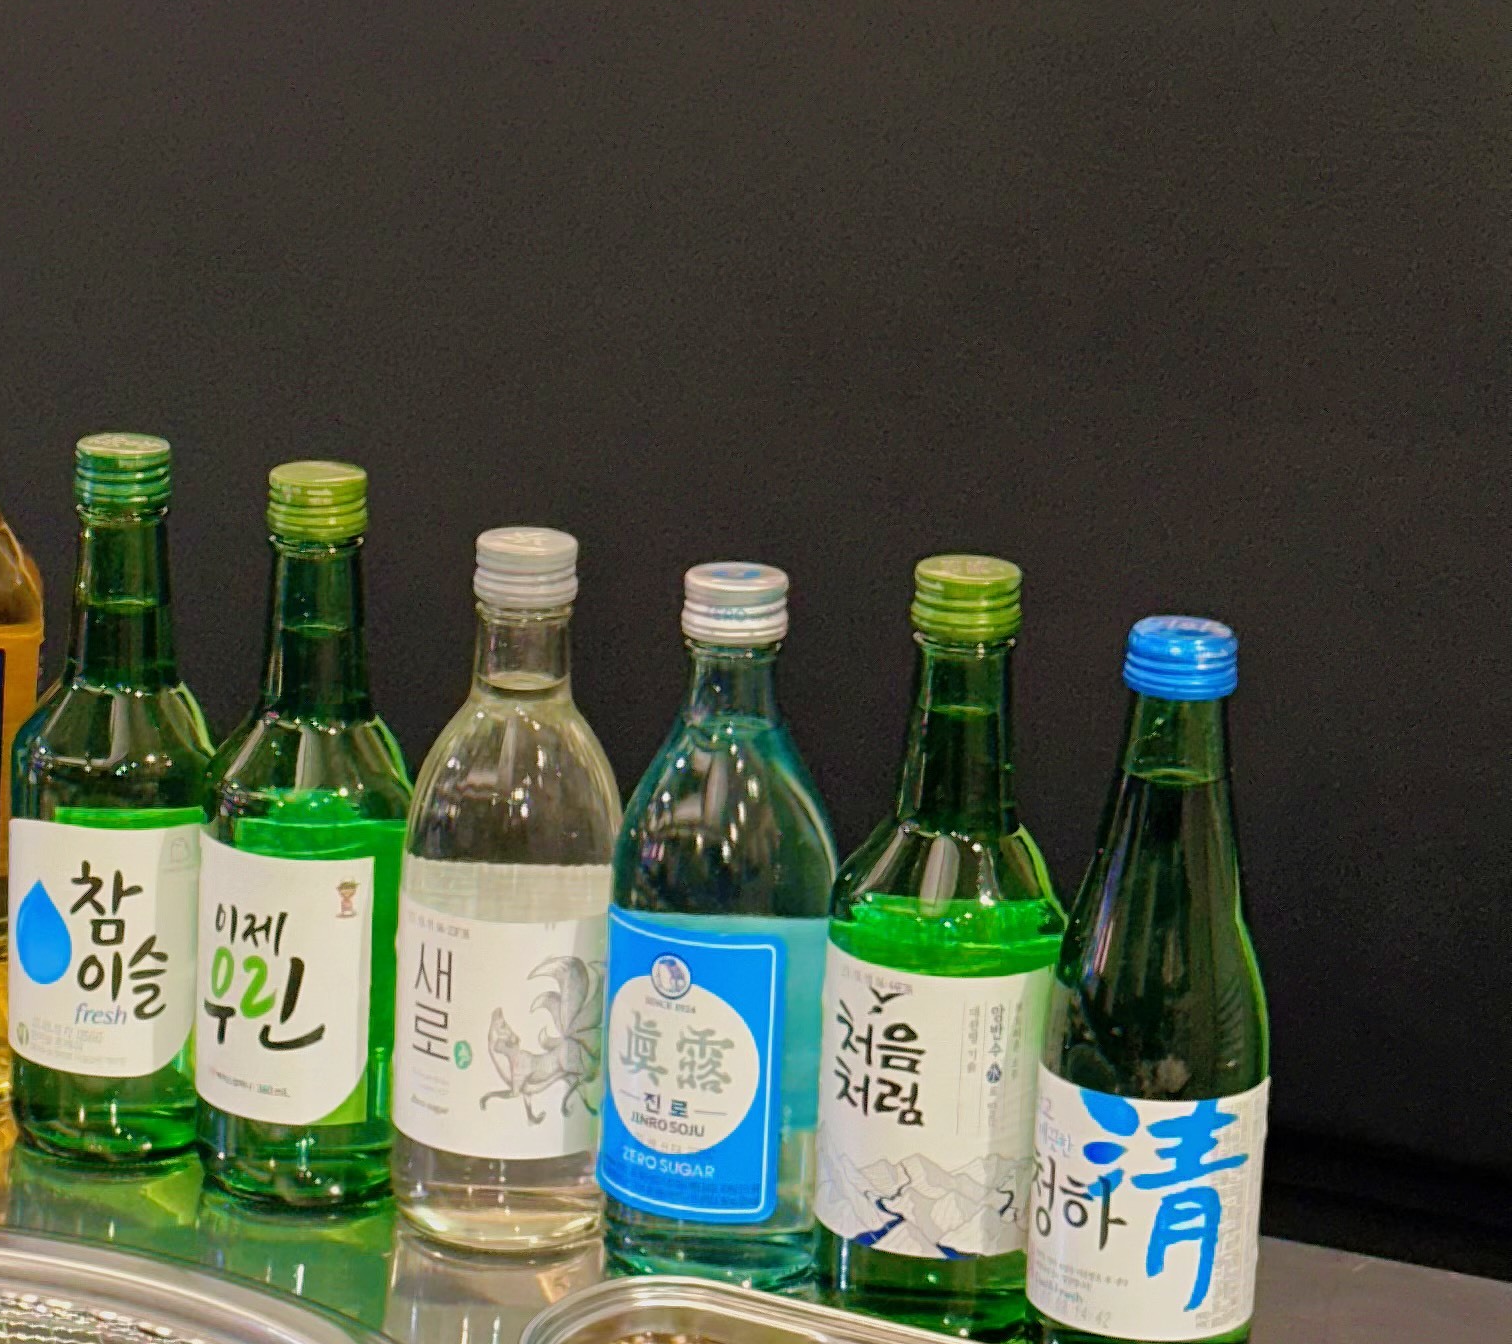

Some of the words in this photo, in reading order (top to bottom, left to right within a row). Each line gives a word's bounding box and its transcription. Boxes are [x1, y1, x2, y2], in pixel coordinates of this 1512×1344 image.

[215, 903, 288, 957] 이제
[77, 934, 169, 1021] 이슬
[411, 941, 453, 1062] 새로
[74, 1002, 127, 1025] fresh
[836, 998, 927, 1067] 처음
[834, 1056, 924, 1127] 처럼
[631, 1111, 668, 1133] JINRO
[669, 1119, 705, 1138] SOJU
[622, 1145, 657, 1170] ZERO
[659, 1158, 715, 1179] SUGAR
